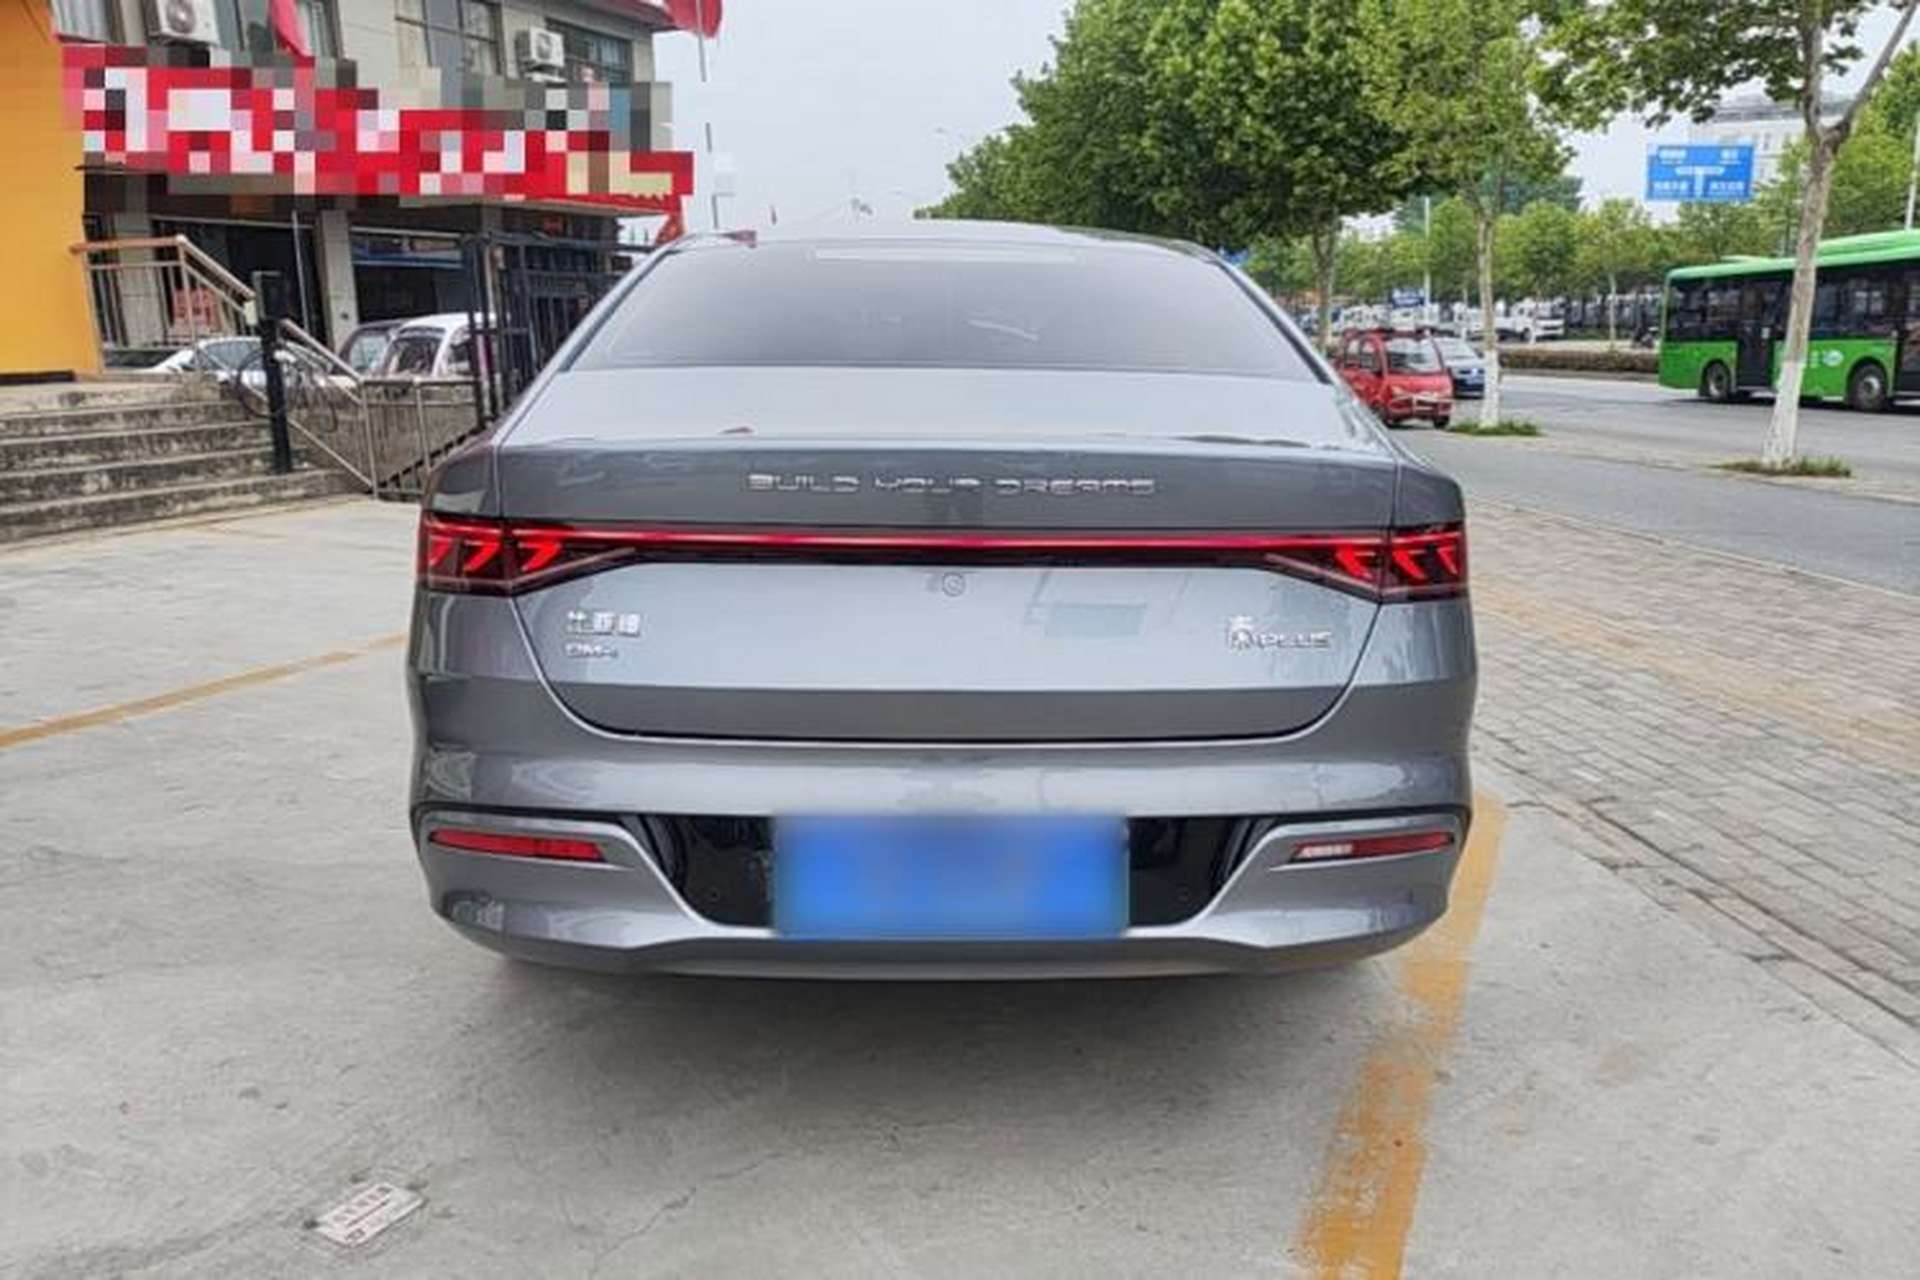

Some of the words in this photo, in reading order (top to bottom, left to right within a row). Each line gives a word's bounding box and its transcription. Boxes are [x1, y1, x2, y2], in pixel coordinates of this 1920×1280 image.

[748, 474, 860, 493] BUILD
[873, 475, 982, 494] YOUR
[995, 477, 1155, 496] DREAMS
